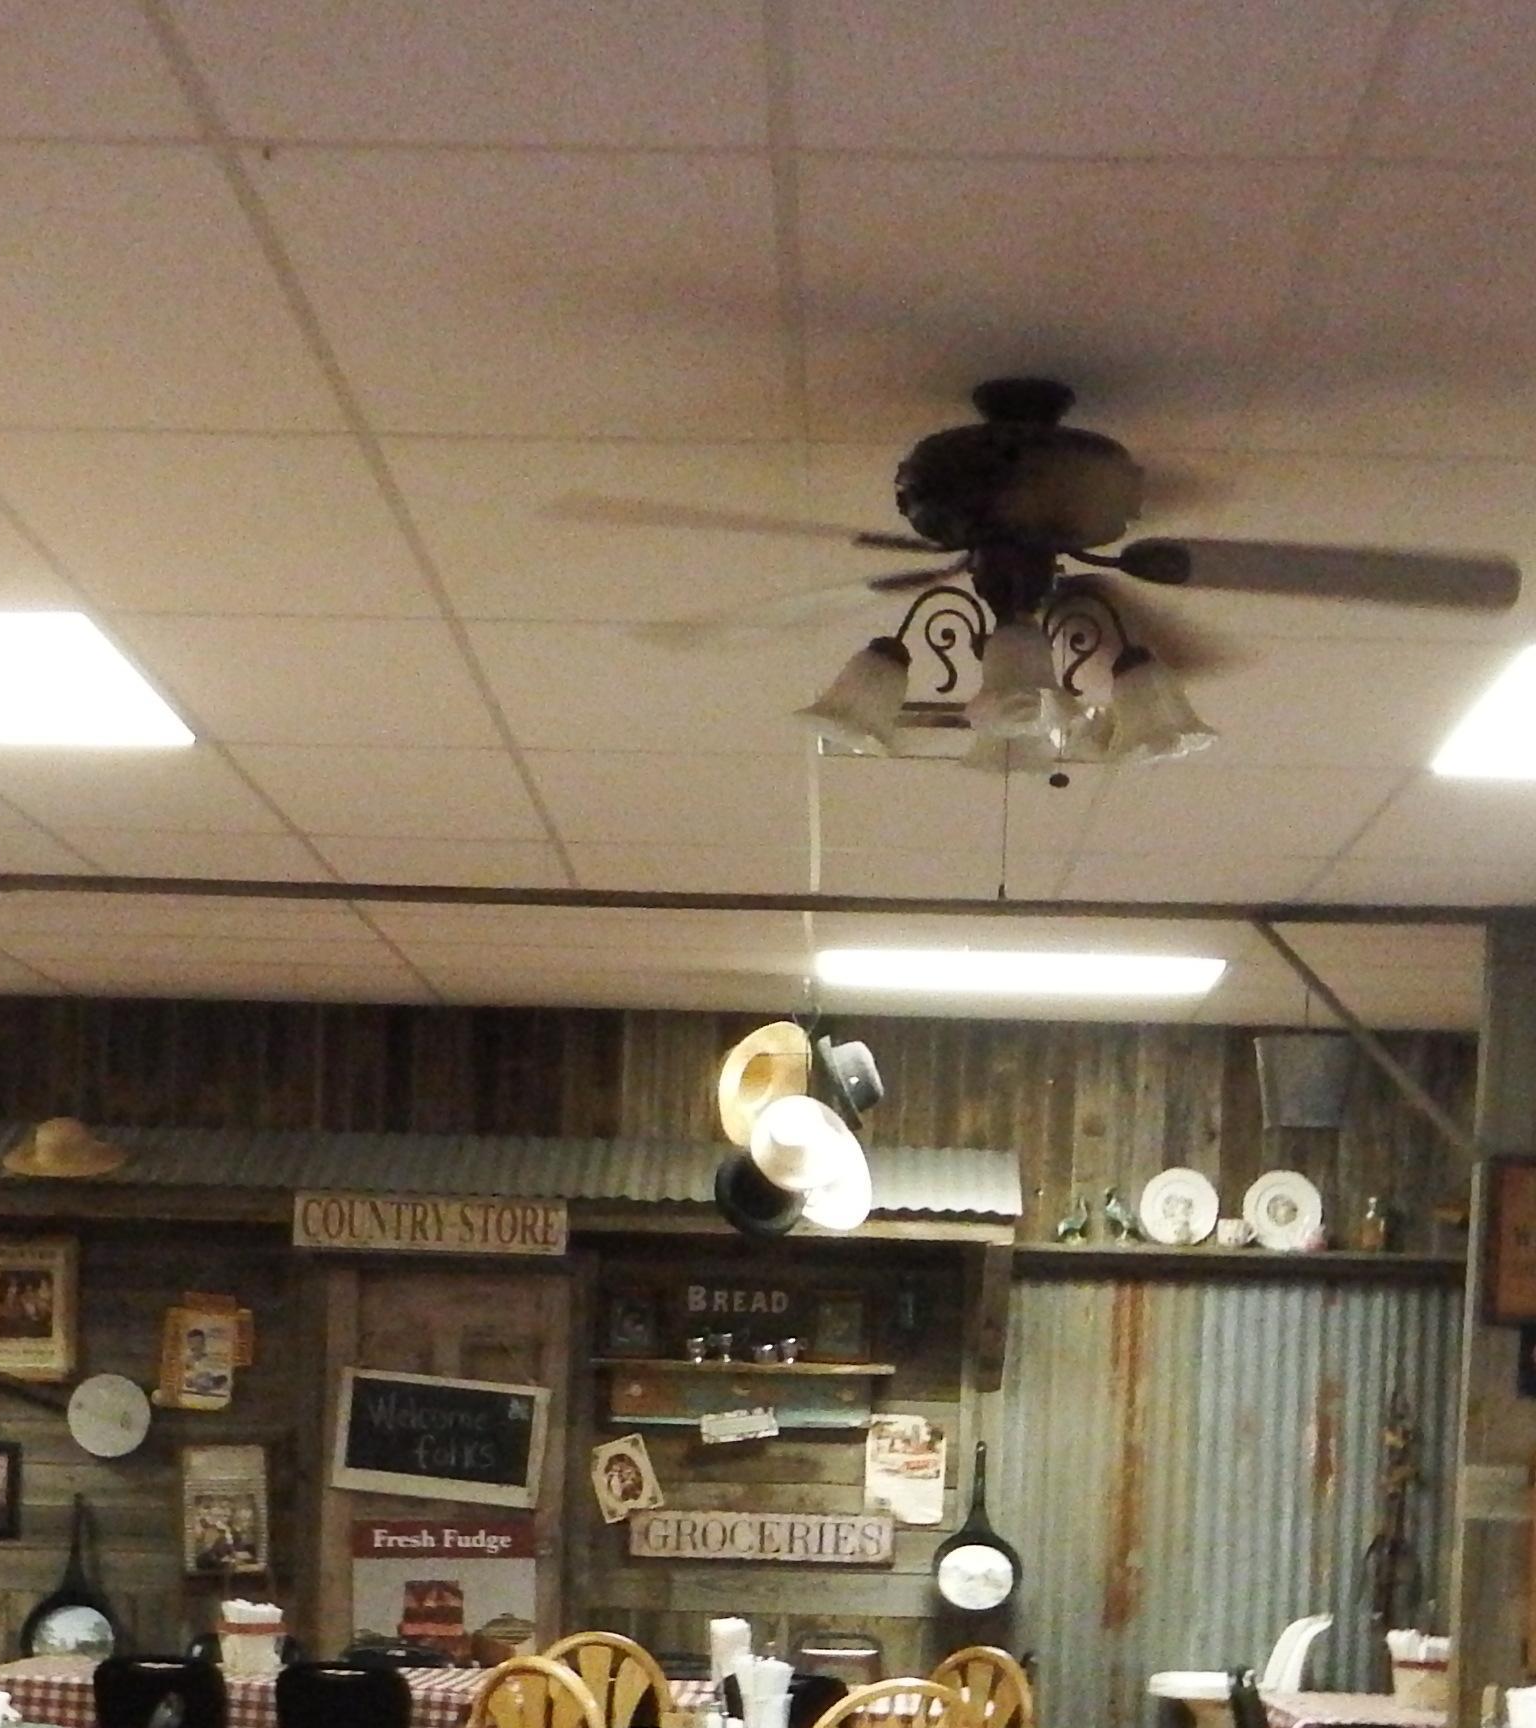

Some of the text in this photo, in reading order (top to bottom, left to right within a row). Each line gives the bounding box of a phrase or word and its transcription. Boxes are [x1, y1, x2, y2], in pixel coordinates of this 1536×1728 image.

[301, 1198, 560, 1247] COUNTRY STORE
[687, 1285, 789, 1314] BREAD
[372, 1529, 512, 1553] Fresh Fudge
[644, 1518, 884, 1557] GROCERIES
